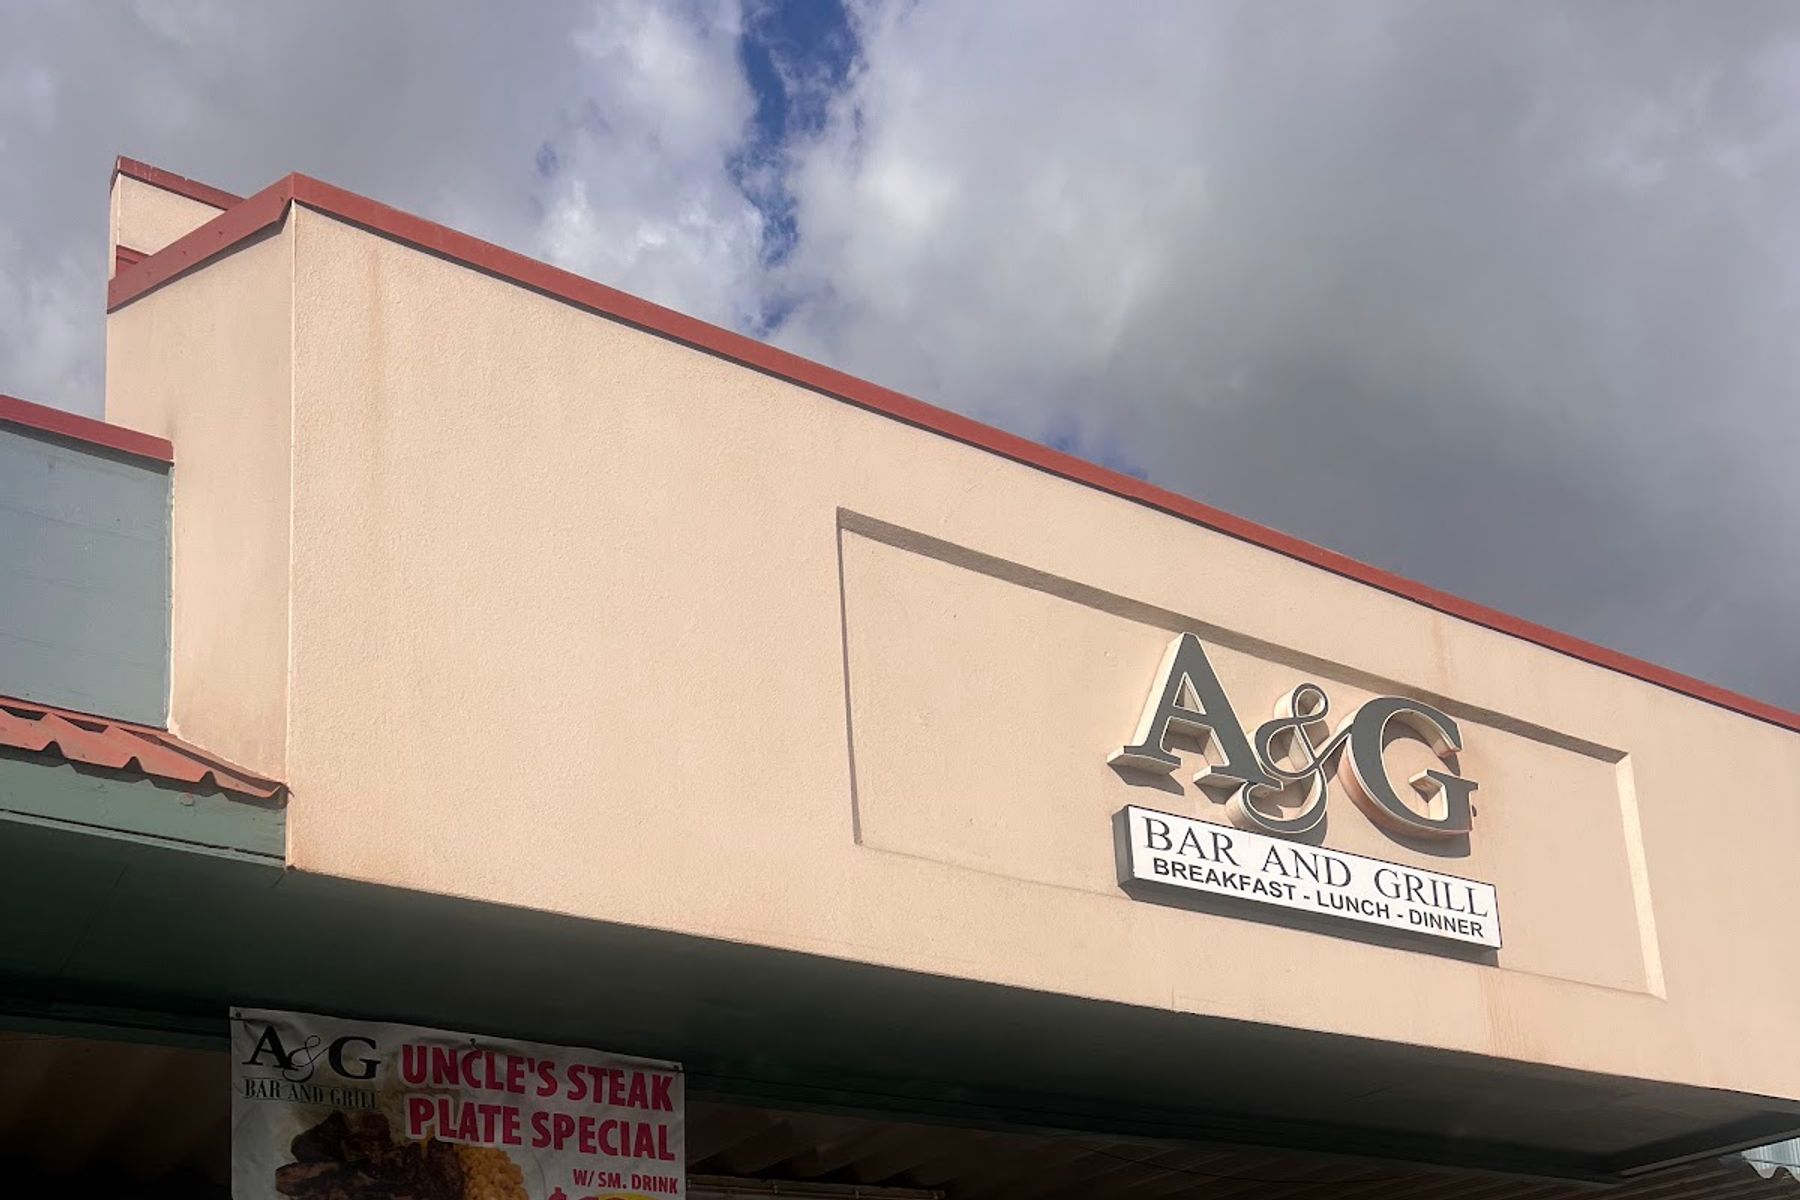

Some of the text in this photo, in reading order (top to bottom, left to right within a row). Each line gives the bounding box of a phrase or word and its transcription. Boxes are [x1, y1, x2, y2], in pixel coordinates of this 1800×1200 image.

[1108, 632, 1479, 836] A&G
[1142, 816, 1490, 918] BAR AND GRILL
[1153, 857, 1297, 901] BREAKFAST
[1316, 890, 1391, 920] LUNCH
[1408, 908, 1485, 939] DINNER
[241, 1024, 382, 1083] A&G
[401, 1043, 675, 1112] UNCLE'S STEAK
[244, 1078, 378, 1110] BAR AND GRILL
[408, 1097, 676, 1162] PLATE SPECIAL
[597, 1171, 627, 1189] SM.
[631, 1173, 679, 1195] DRINK
